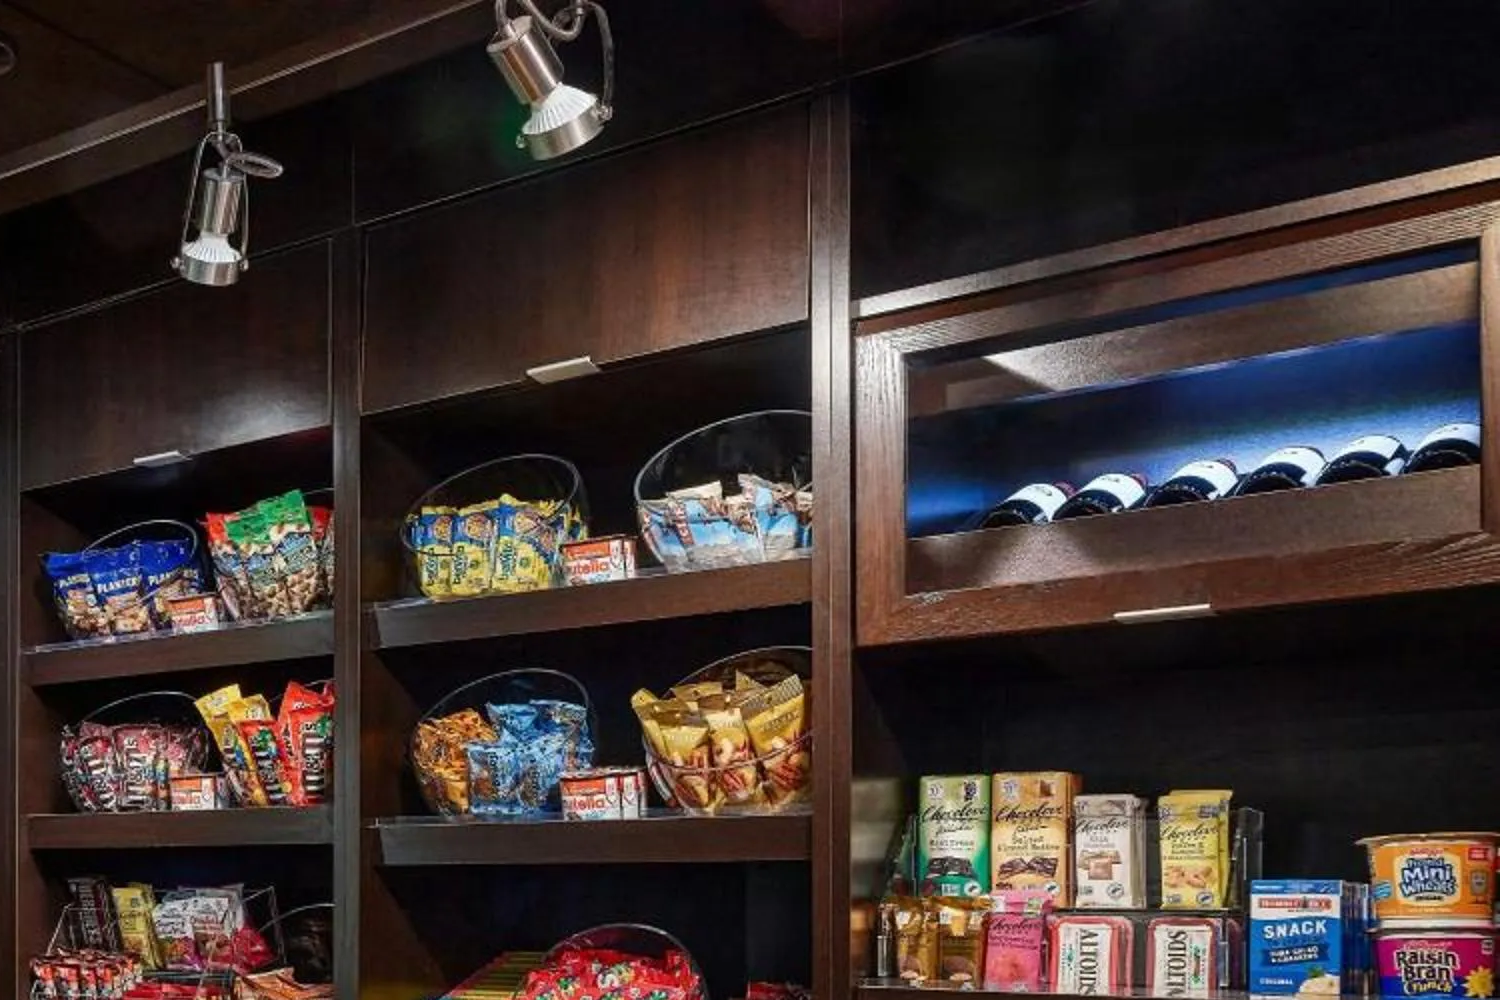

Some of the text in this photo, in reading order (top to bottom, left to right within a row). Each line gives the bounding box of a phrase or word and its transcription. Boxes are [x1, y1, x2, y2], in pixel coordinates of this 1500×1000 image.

[1402, 866, 1451, 883] Mini
[1263, 920, 1328, 940] SNACK
[1166, 930, 1189, 997] ALTOIDS
[1395, 950, 1459, 968] Raisin
[1403, 965, 1451, 982] Bran
